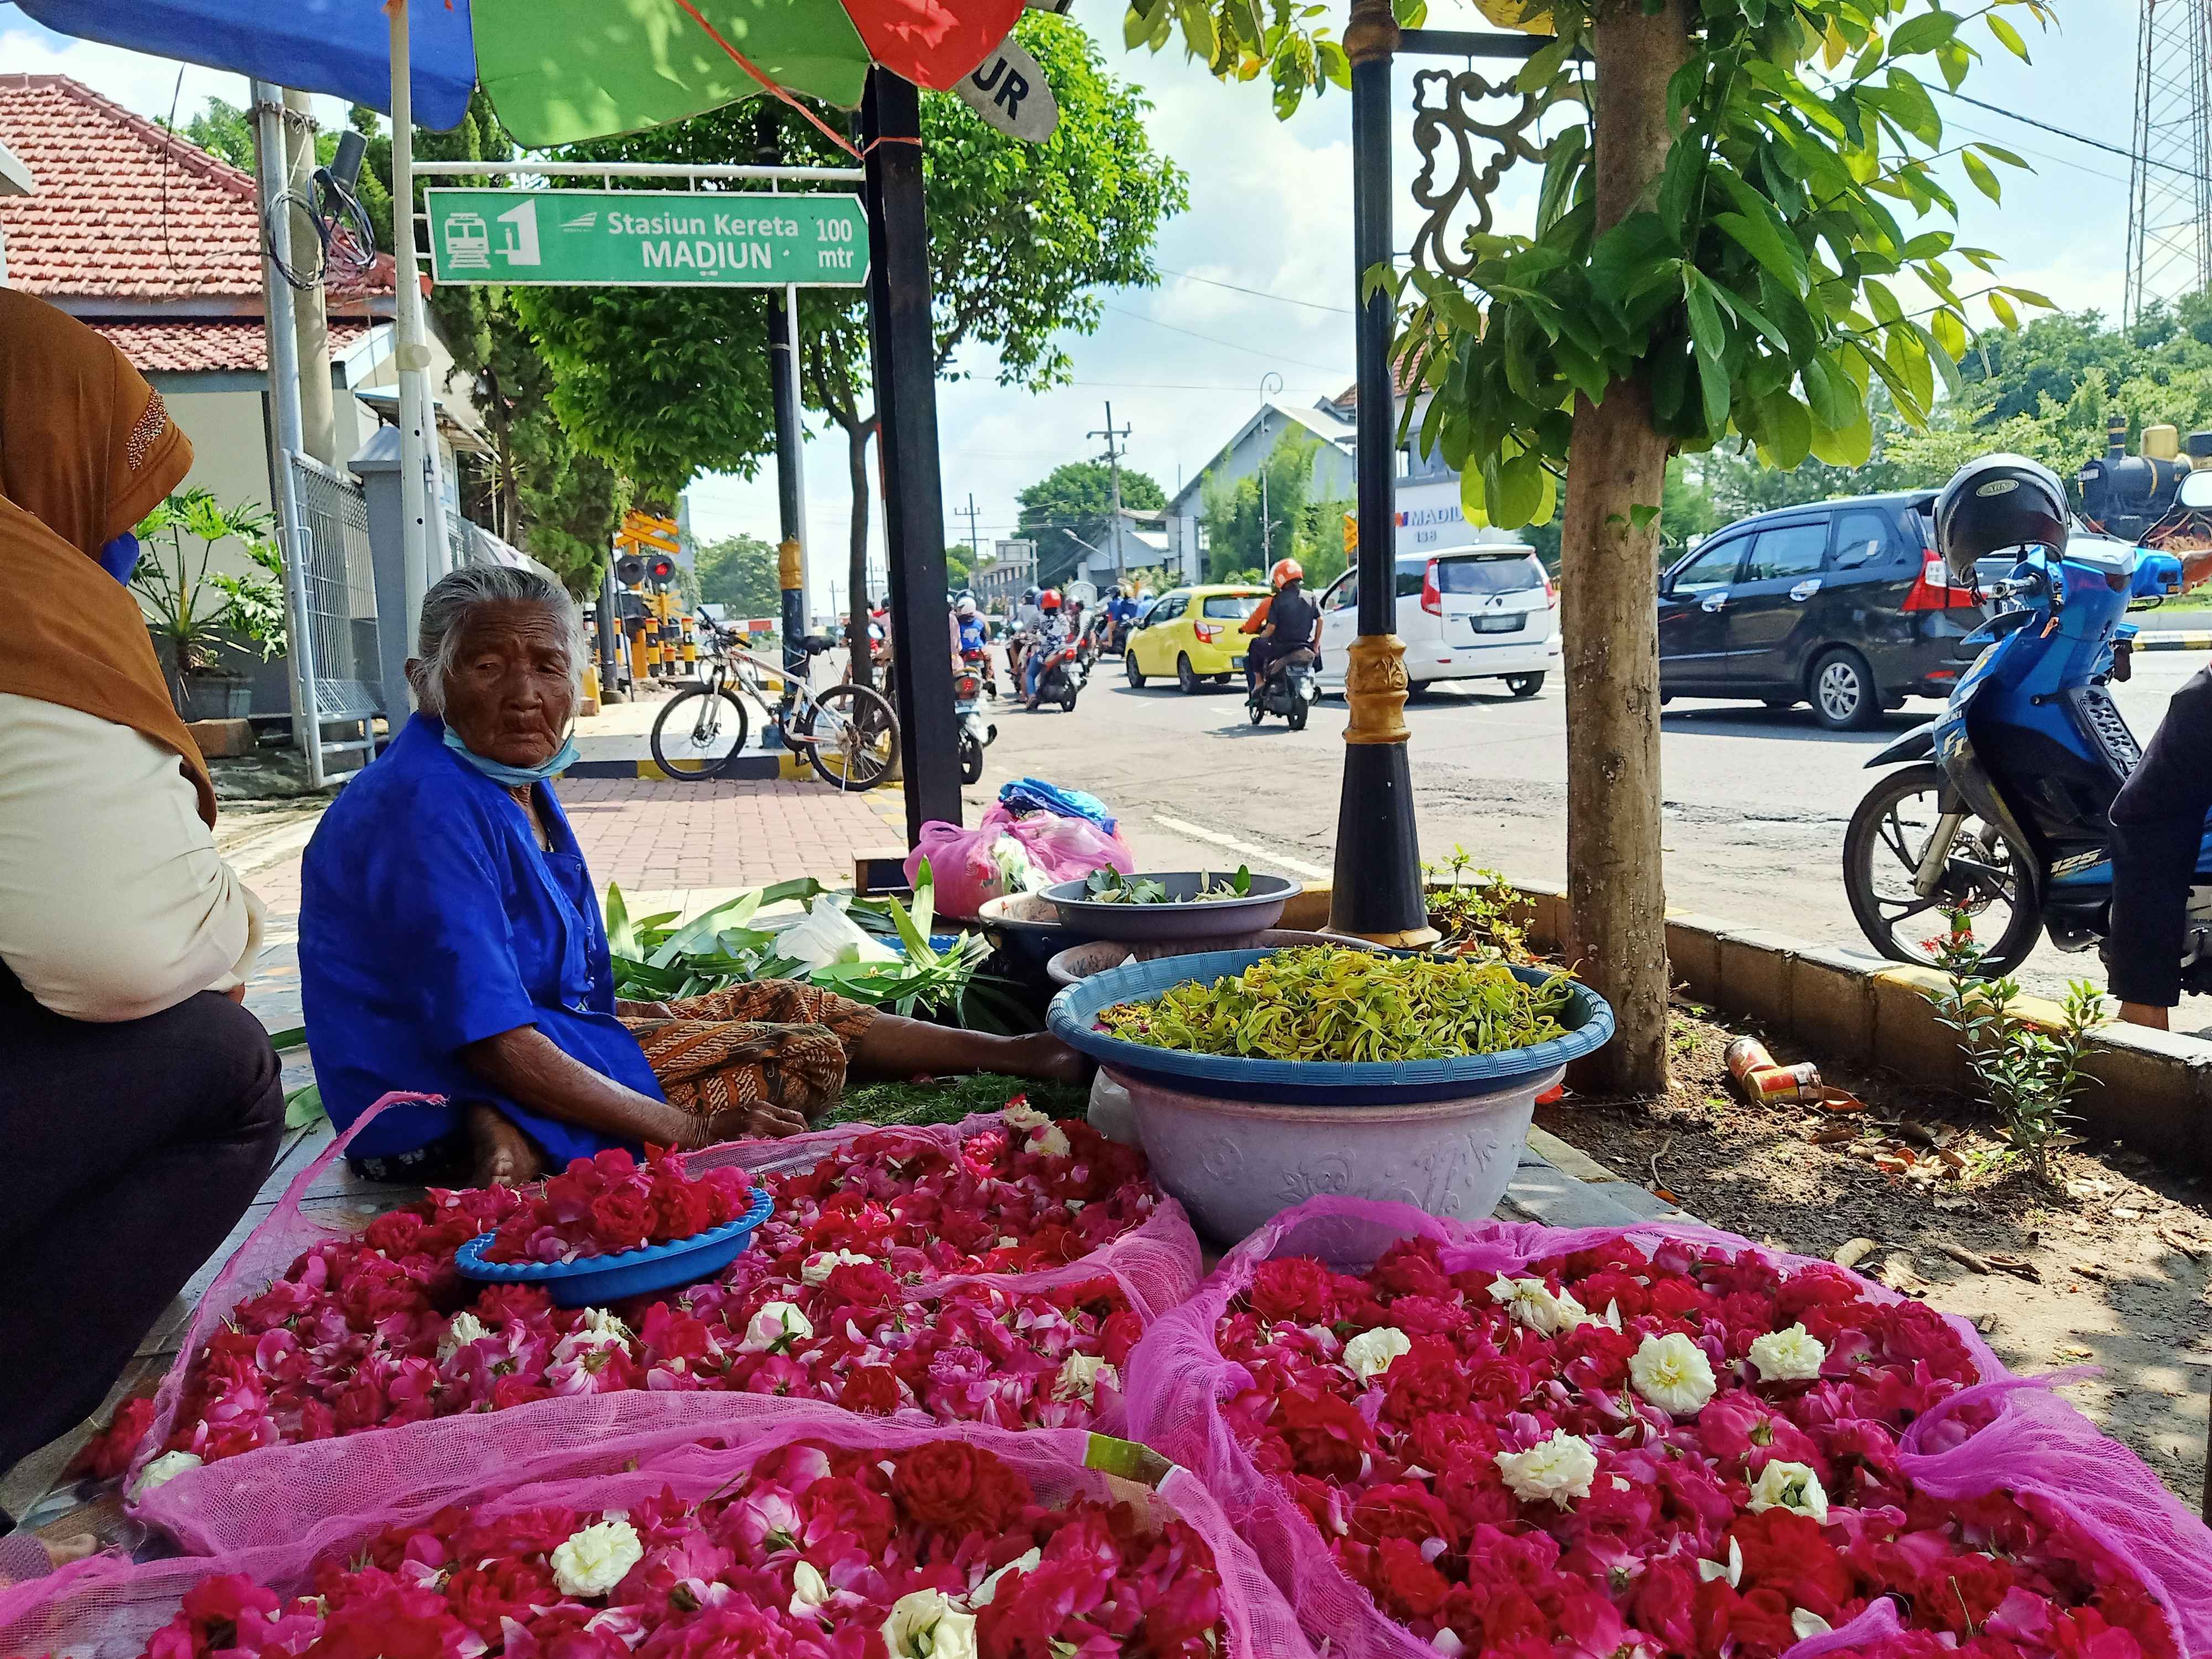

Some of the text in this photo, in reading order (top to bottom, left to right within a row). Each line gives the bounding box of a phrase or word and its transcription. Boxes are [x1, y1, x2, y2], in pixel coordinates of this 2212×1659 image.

[608, 211, 799, 237] Stasiun Kereta
[816, 218, 853, 242] 100
[641, 240, 772, 269] MADIUN
[818, 246, 854, 268] mtr
[2050, 848, 2102, 874] 125
